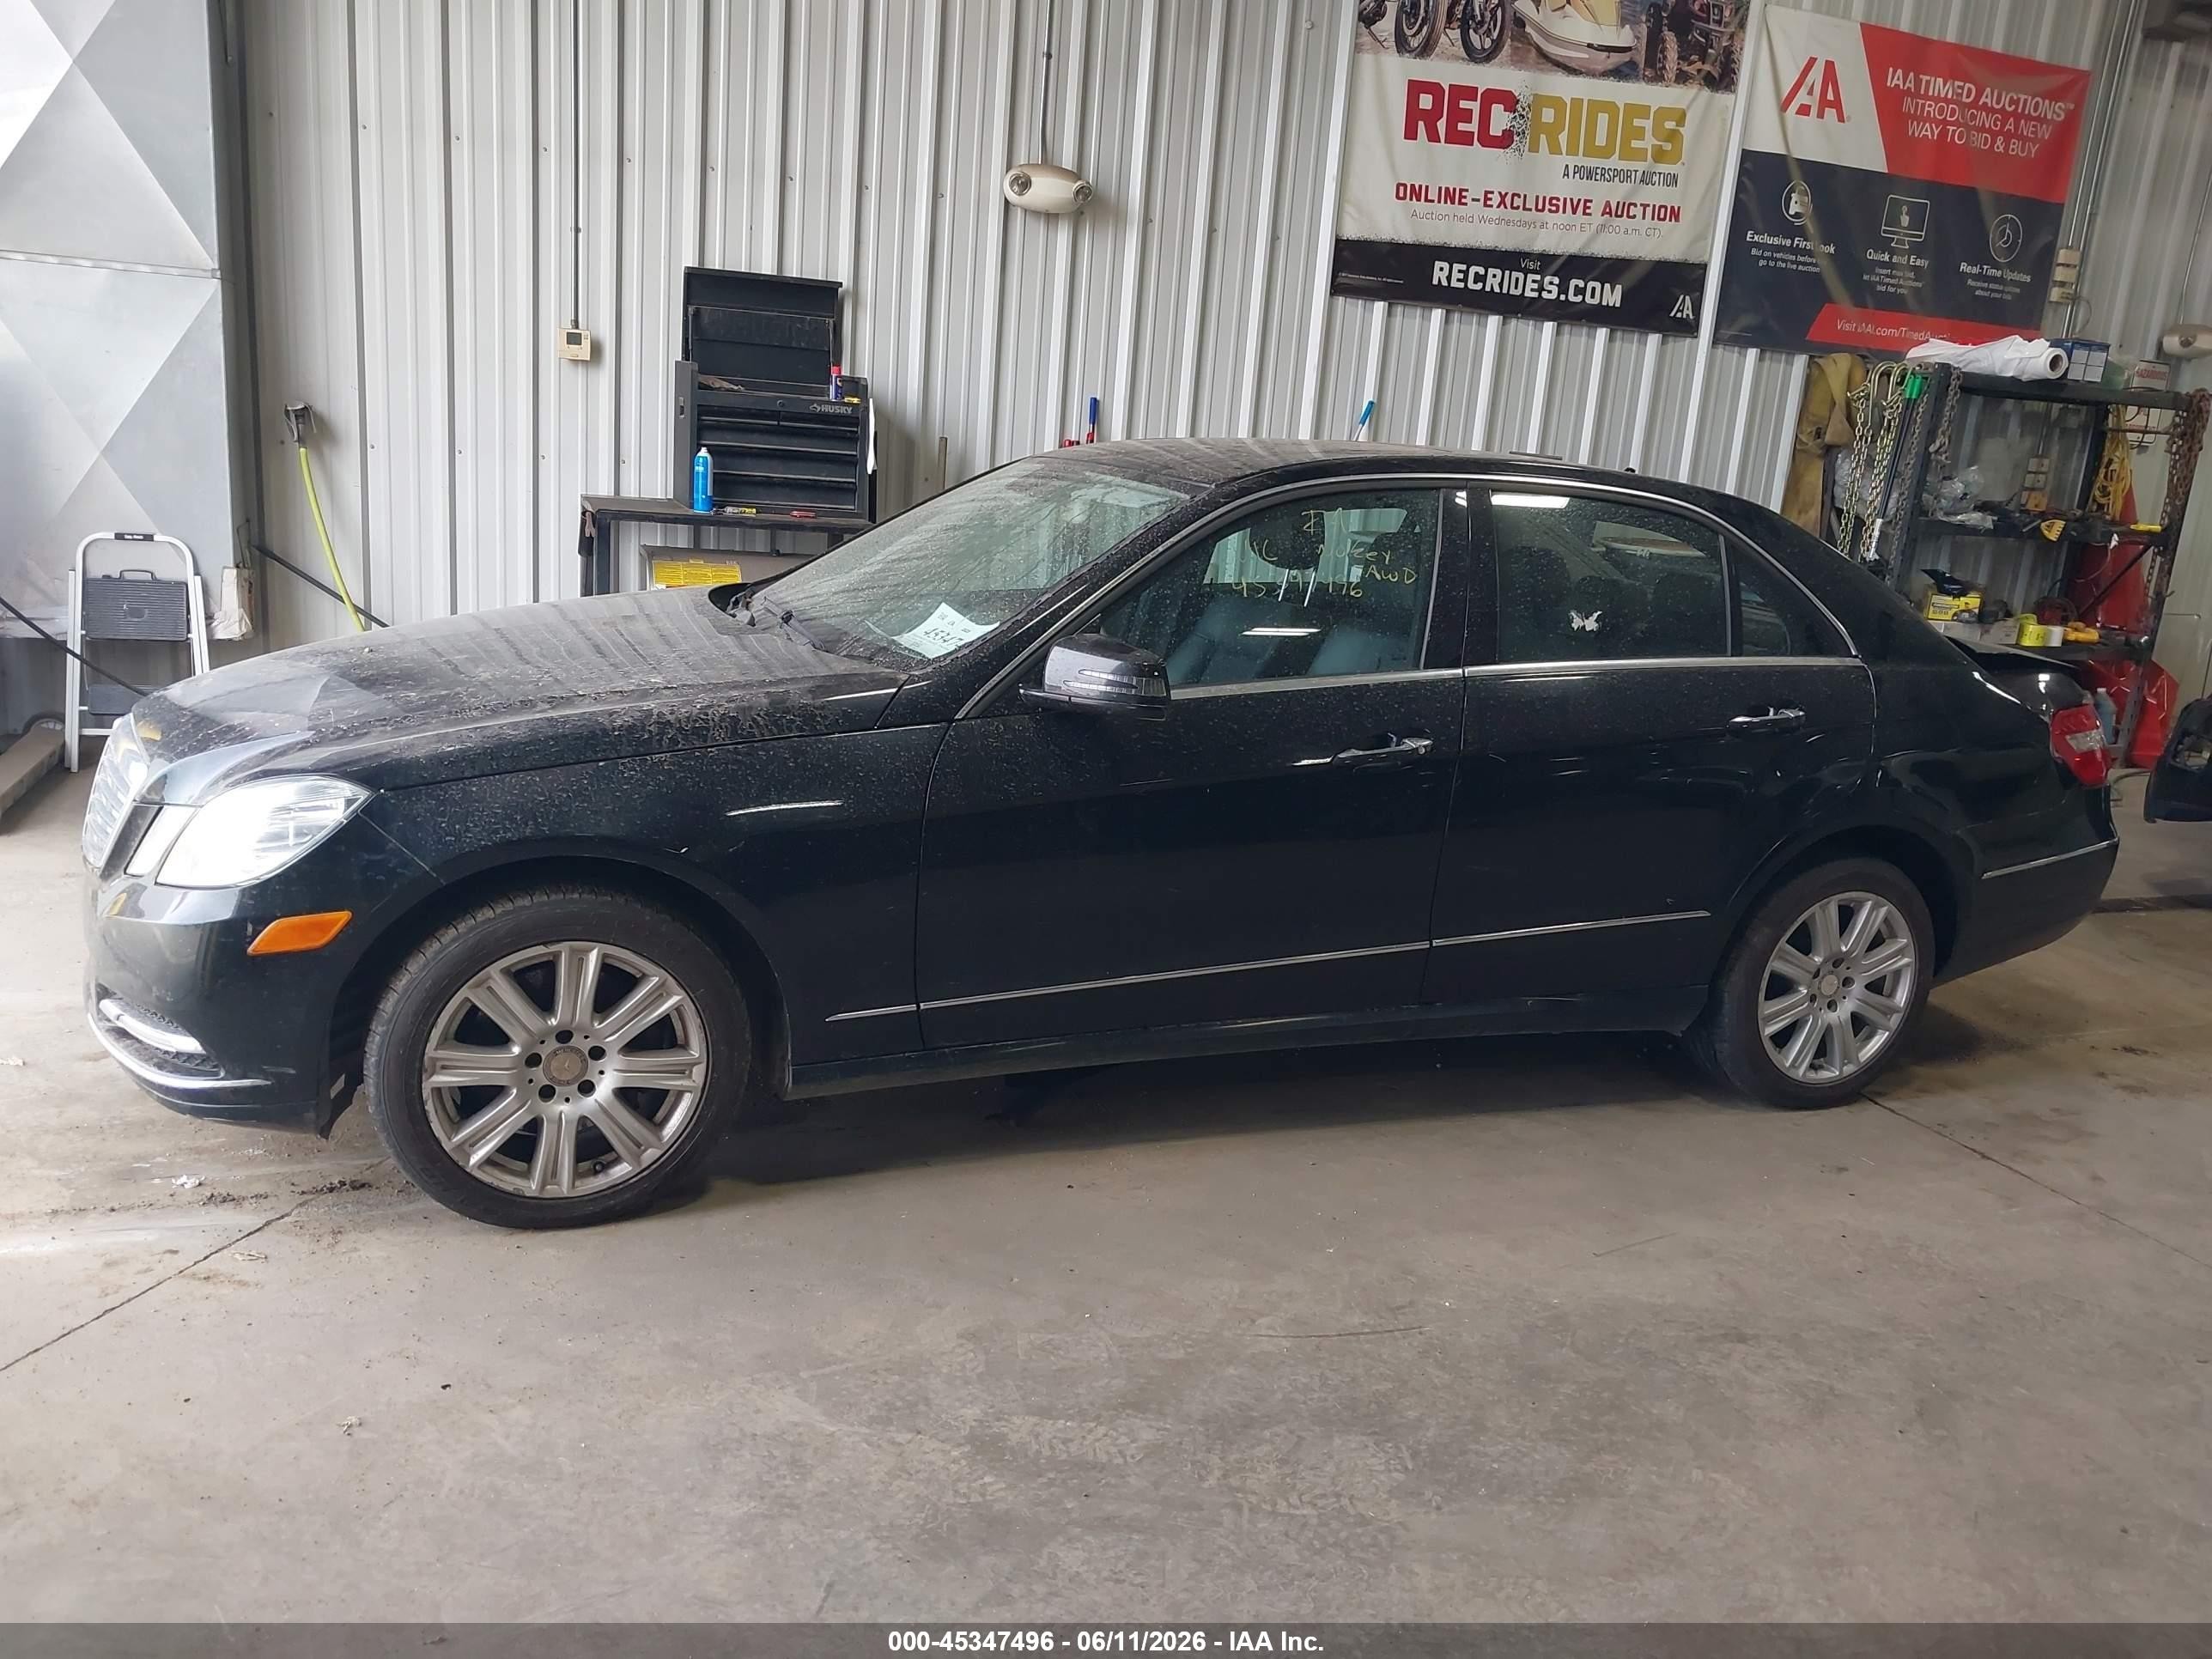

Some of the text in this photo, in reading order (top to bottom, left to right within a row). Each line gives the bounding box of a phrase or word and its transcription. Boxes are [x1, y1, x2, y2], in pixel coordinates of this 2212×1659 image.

[1887, 67, 1915, 93] IAA
[1918, 74, 1976, 103] TIMED
[1403, 78, 1686, 166] REC RIDES
[1902, 96, 2053, 140] INTRODUCING A NEW
[1907, 119, 2040, 158] WAY TO BID & BUY
[1562, 163, 1679, 188] A POWERSPORT AUCTION
[1395, 182, 1681, 223] ONLINE-EXCLUSIVE AUCTION
[1411, 209, 1450, 222] Auction
[1453, 214, 1474, 223] held
[1477, 215, 1537, 230] Wednesdays
[1539, 221, 1549, 230] at
[1552, 222, 1577, 233] noon
[1579, 222, 1594, 233] ET
[1623, 227, 1642, 236] a.m.
[1746, 230, 1792, 247] Exclusive
[1520, 258, 1541, 270] Visit
[1750, 247, 1763, 256] Bid
[1866, 249, 1929, 268] Quick and Easy
[1431, 260, 1622, 307] RECRIDES.COM
[1960, 262, 2032, 283] Real-Time Updates
[1837, 319, 1856, 332] Visit
[821, 404, 853, 414] HUSKY
